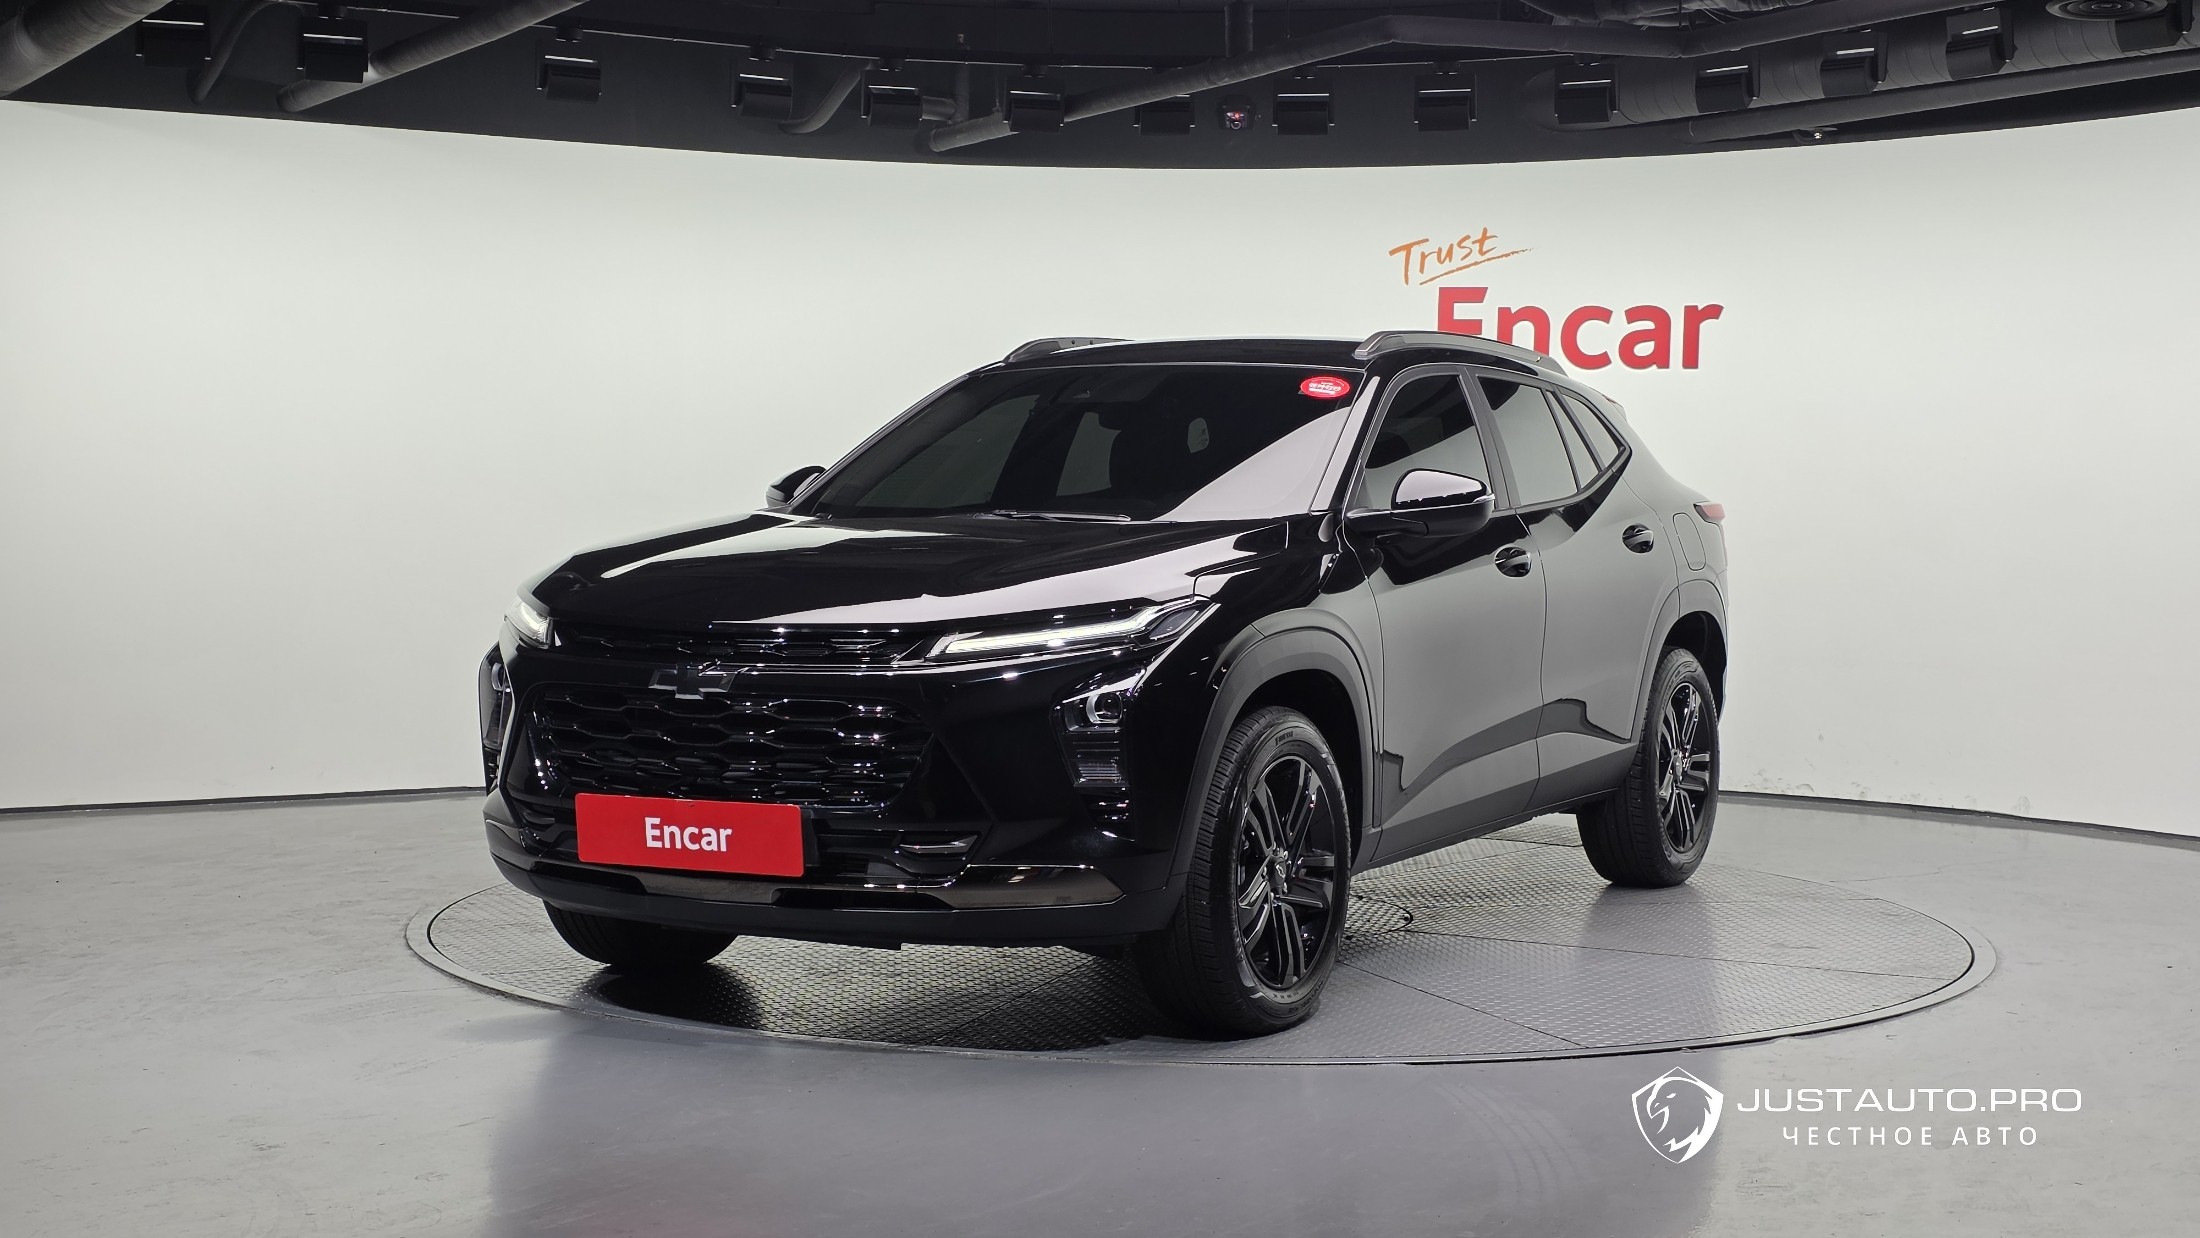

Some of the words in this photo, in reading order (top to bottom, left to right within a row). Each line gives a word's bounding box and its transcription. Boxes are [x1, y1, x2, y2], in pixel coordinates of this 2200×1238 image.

[1388, 226, 1499, 286] Trust
[1437, 287, 1724, 370] Encar
[644, 816, 733, 852] Encar
